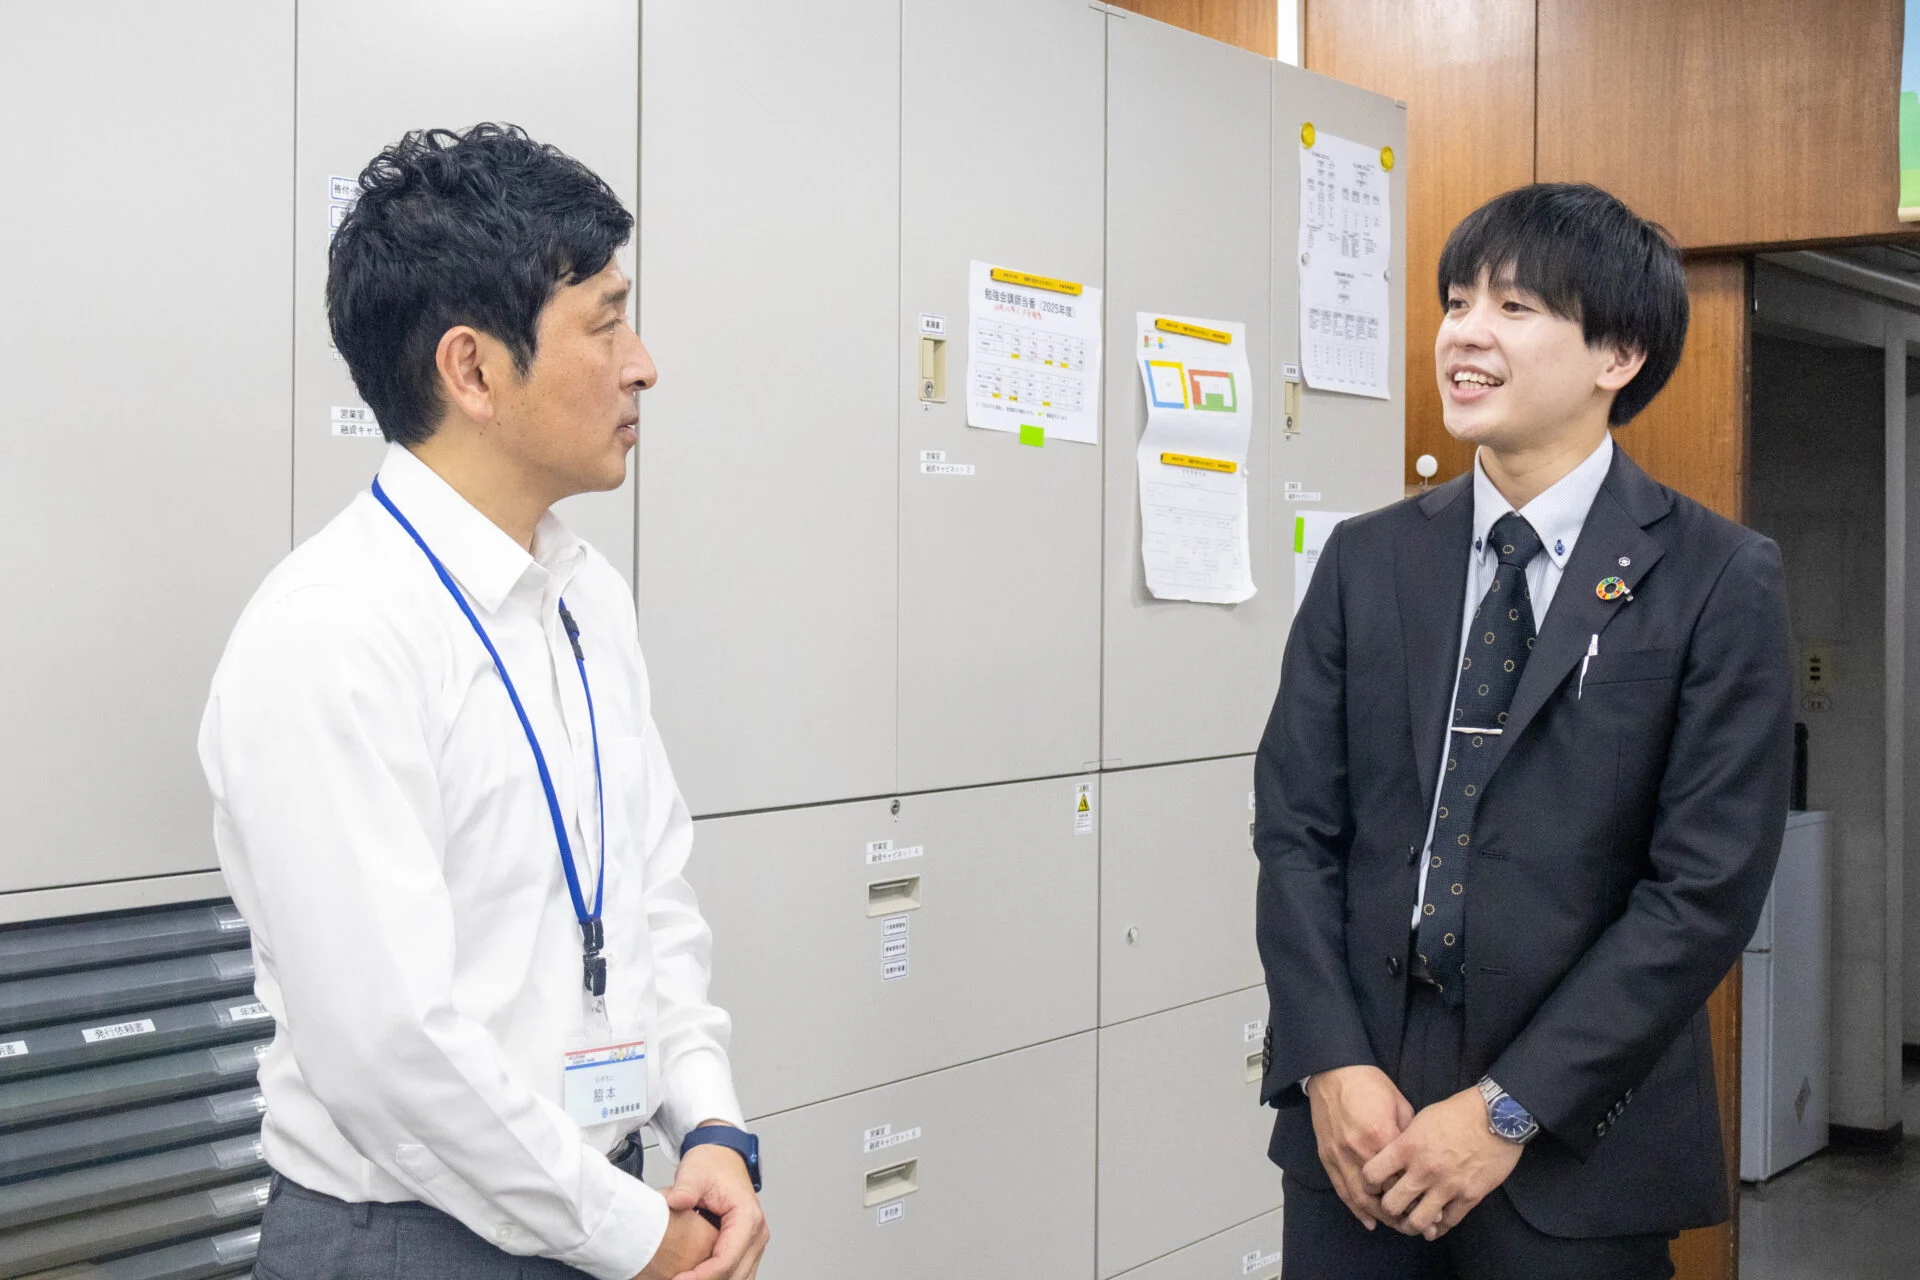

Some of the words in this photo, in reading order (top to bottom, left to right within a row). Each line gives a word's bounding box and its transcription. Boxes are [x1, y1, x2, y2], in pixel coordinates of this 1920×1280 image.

[95, 1022, 144, 1039] 発行依頼書
